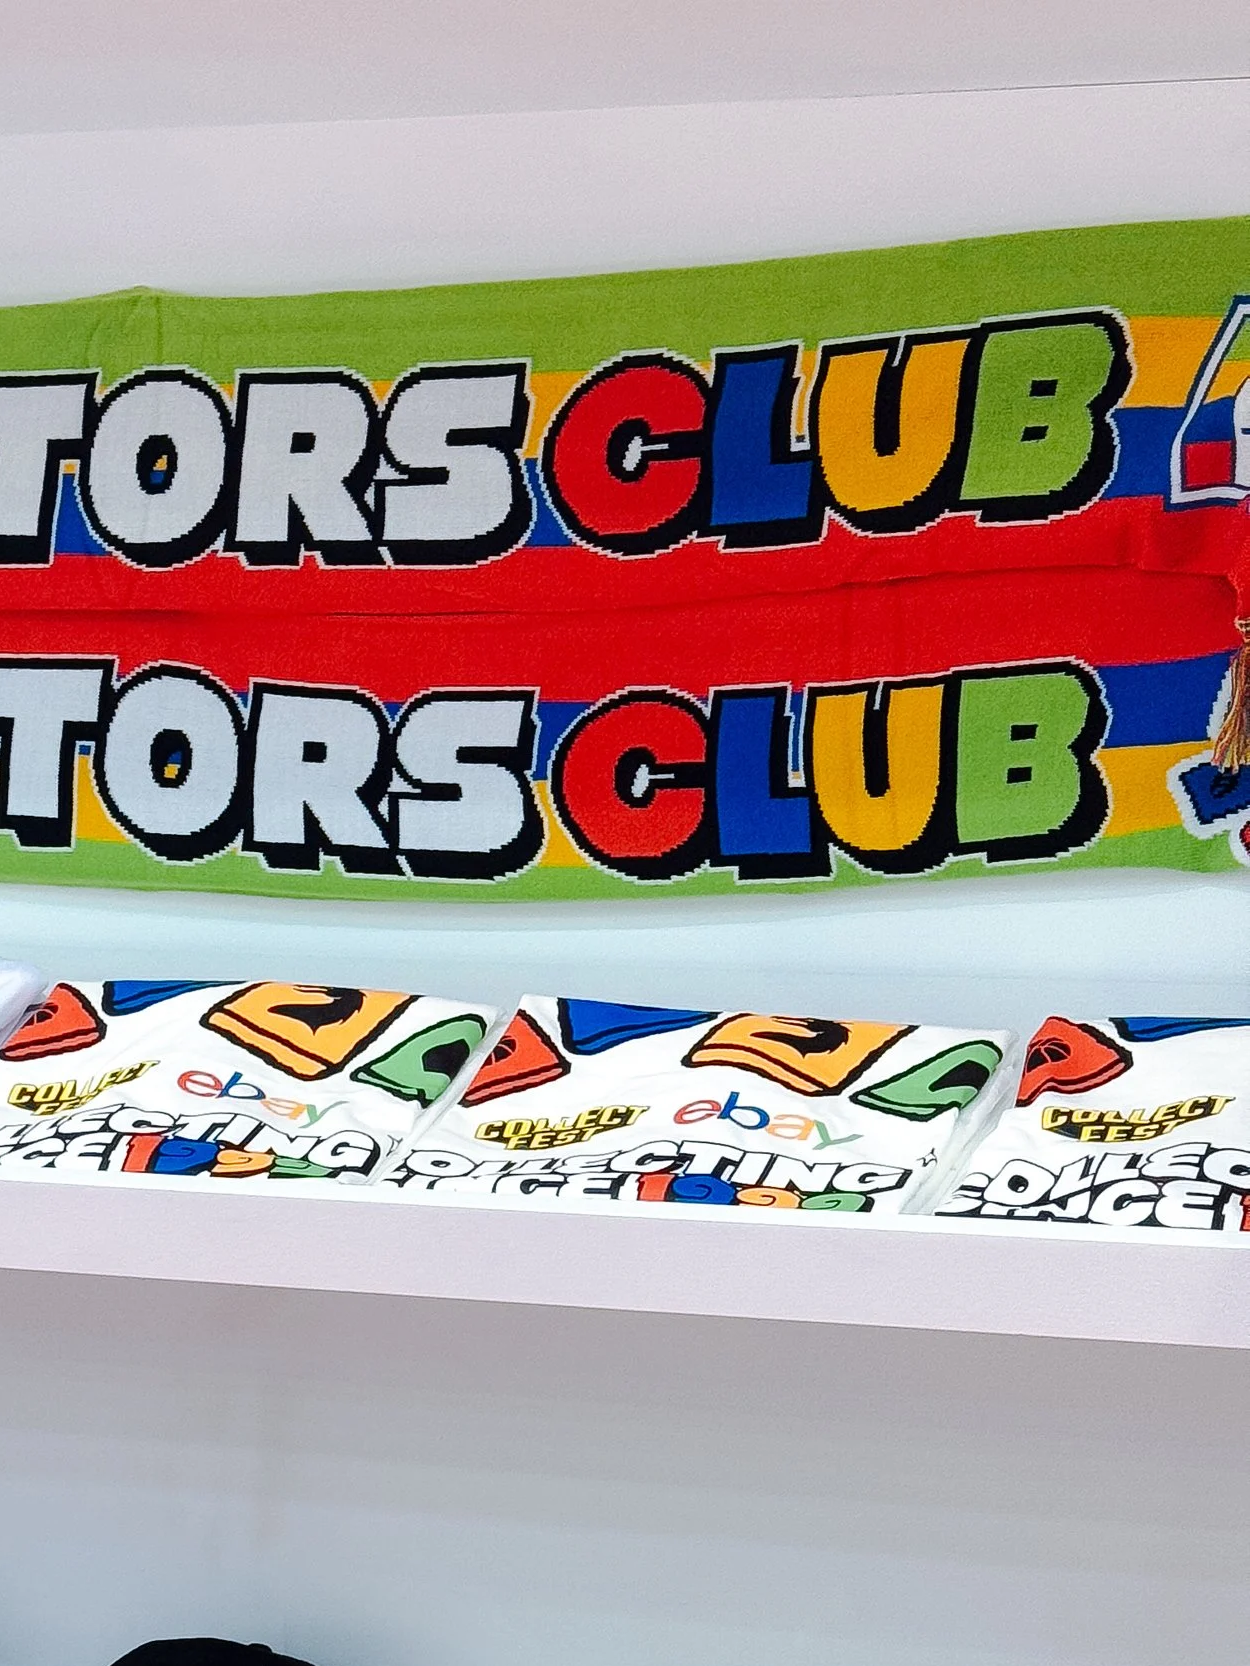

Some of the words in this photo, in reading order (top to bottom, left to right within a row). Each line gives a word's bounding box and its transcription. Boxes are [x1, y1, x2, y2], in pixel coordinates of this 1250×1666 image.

[546, 308, 1131, 557] CLUB
[552, 657, 1111, 882] CLUB
[177, 1070, 350, 1128] ebay
[474, 1105, 650, 1142] COLLECT
[674, 1091, 864, 1150] ebay
[1041, 1095, 1236, 1133] COLLECT
[505, 1126, 605, 1151] FEST
[1080, 1118, 1188, 1143] FEST
[393, 1140, 913, 1196] OLLECTING
